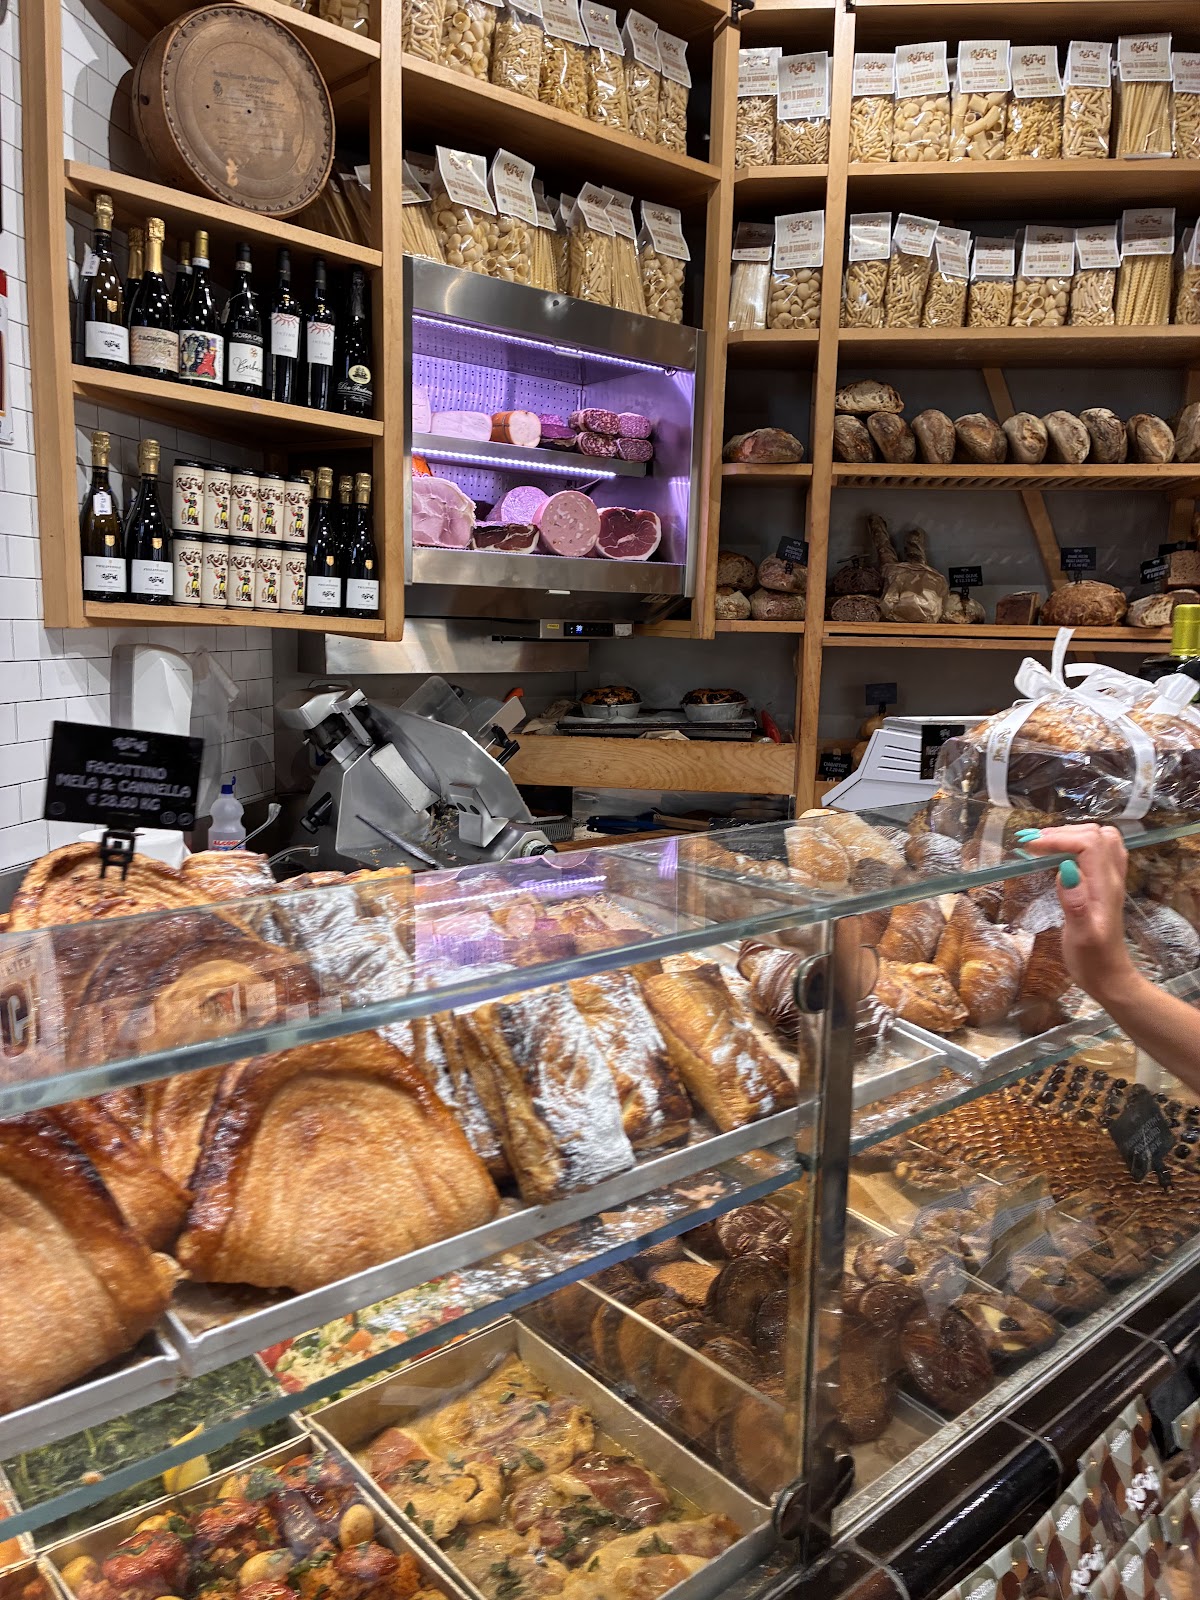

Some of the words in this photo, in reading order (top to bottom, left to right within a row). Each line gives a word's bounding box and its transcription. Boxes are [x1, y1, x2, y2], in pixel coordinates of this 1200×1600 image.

[85, 759, 167, 780] FAGOTTINO
[55, 773, 99, 790] MELA
[100, 777, 116, 791] &
[117, 780, 192, 798] CANNELLA
[140, 797, 161, 811] KG
